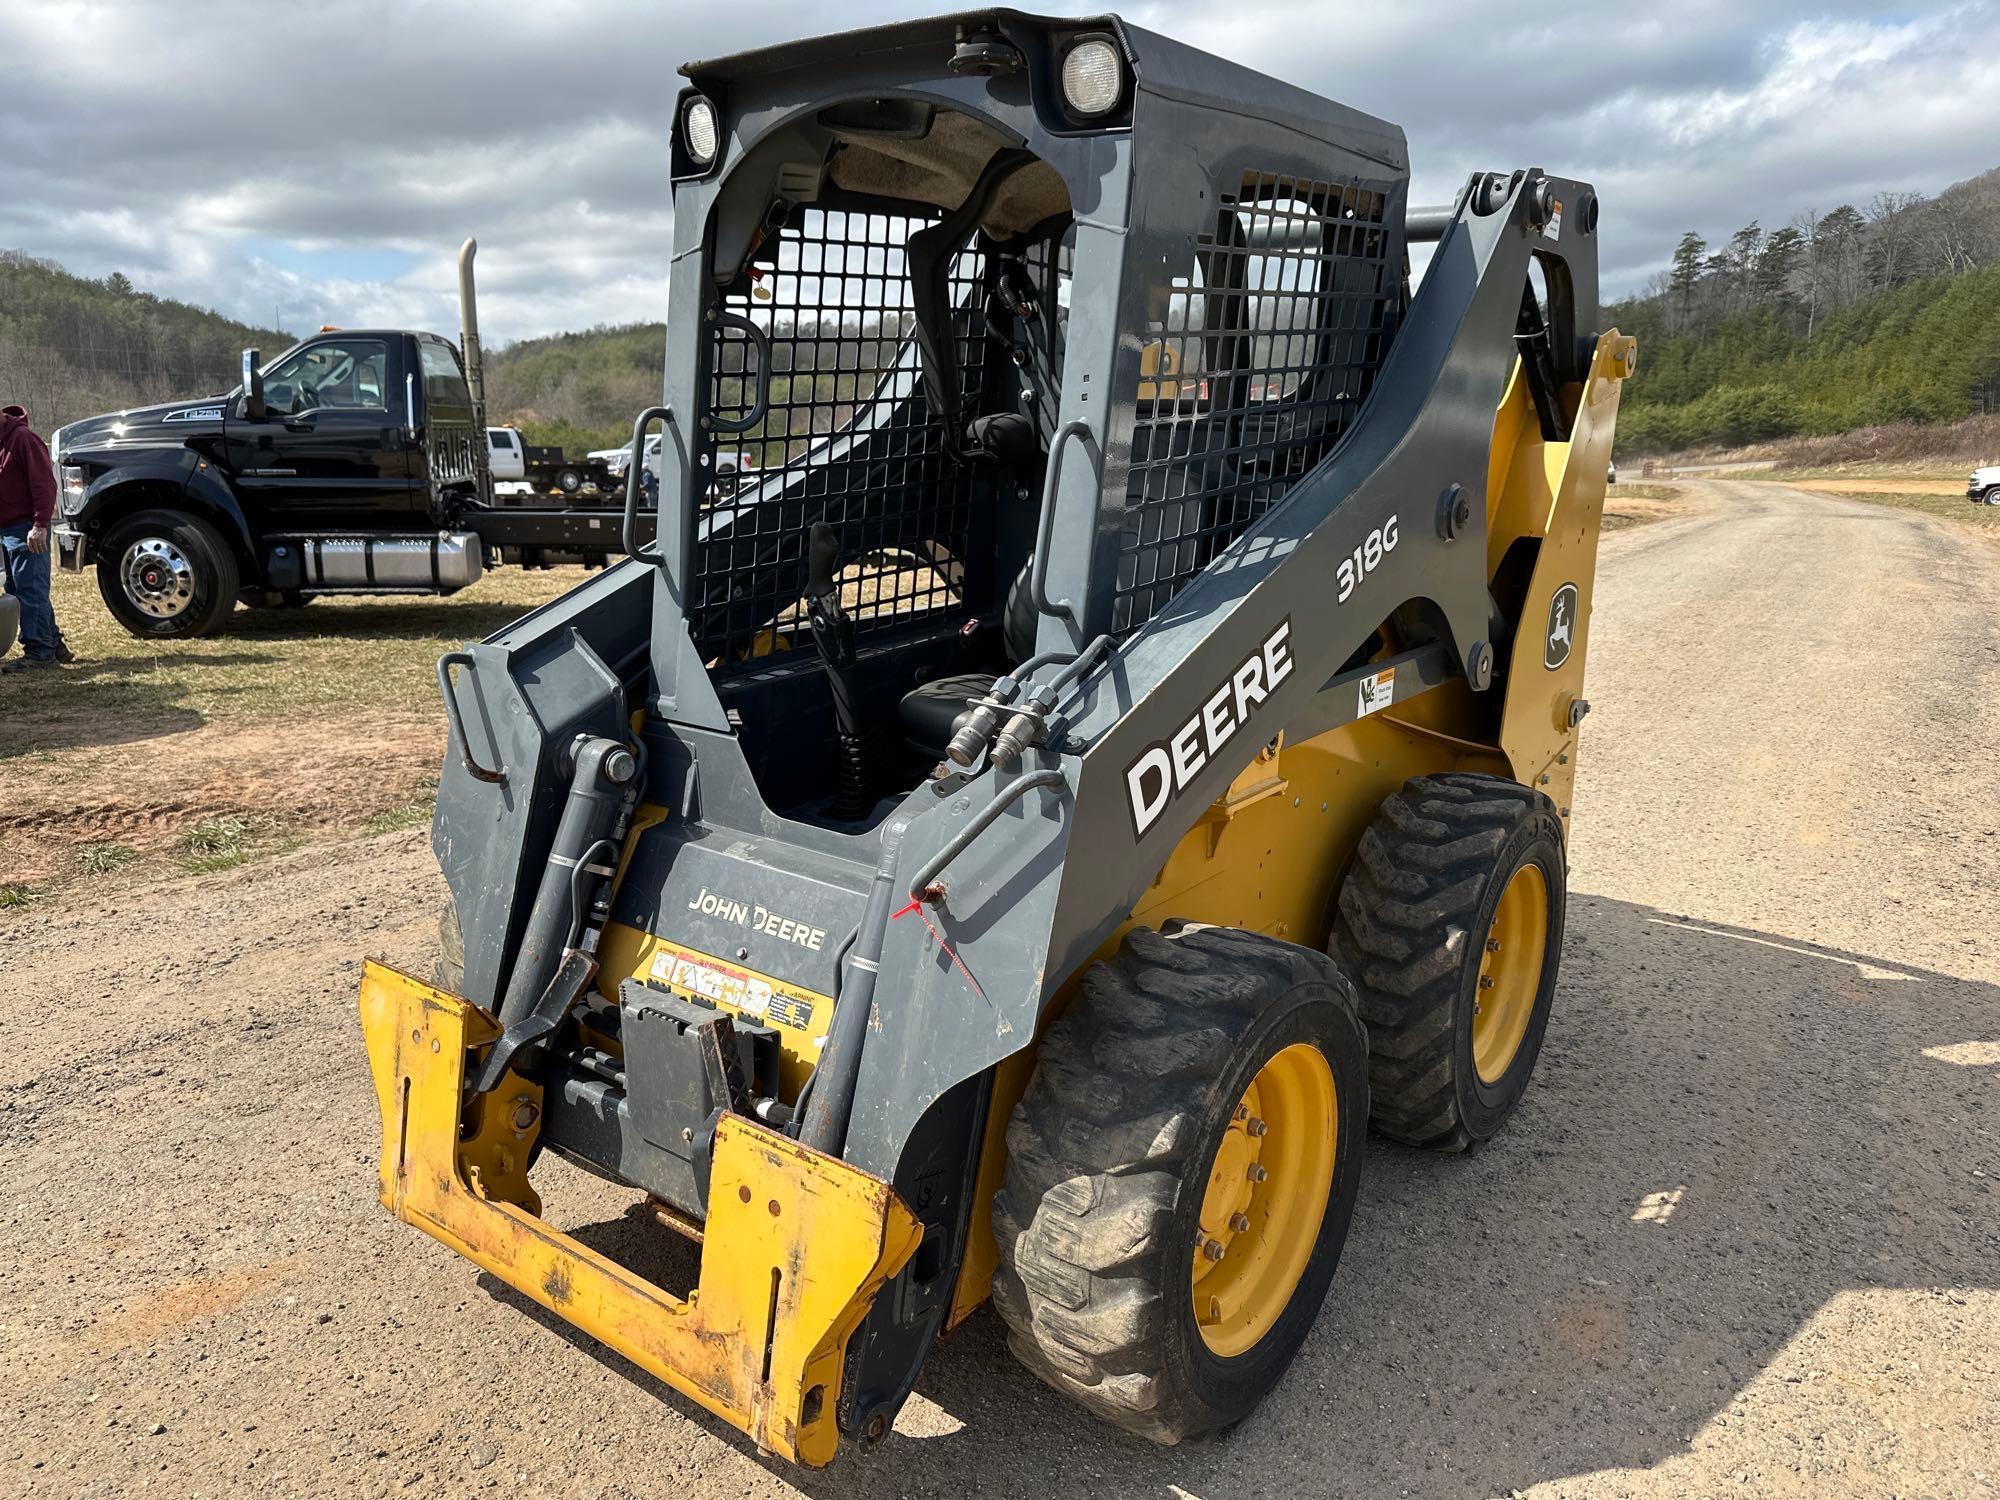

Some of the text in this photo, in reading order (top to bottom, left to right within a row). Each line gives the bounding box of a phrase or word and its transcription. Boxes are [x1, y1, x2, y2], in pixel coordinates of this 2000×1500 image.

[1336, 514, 1399, 604] 318G
[1127, 621, 1293, 835] DEERE
[688, 888, 826, 951] JOHN DEERE
